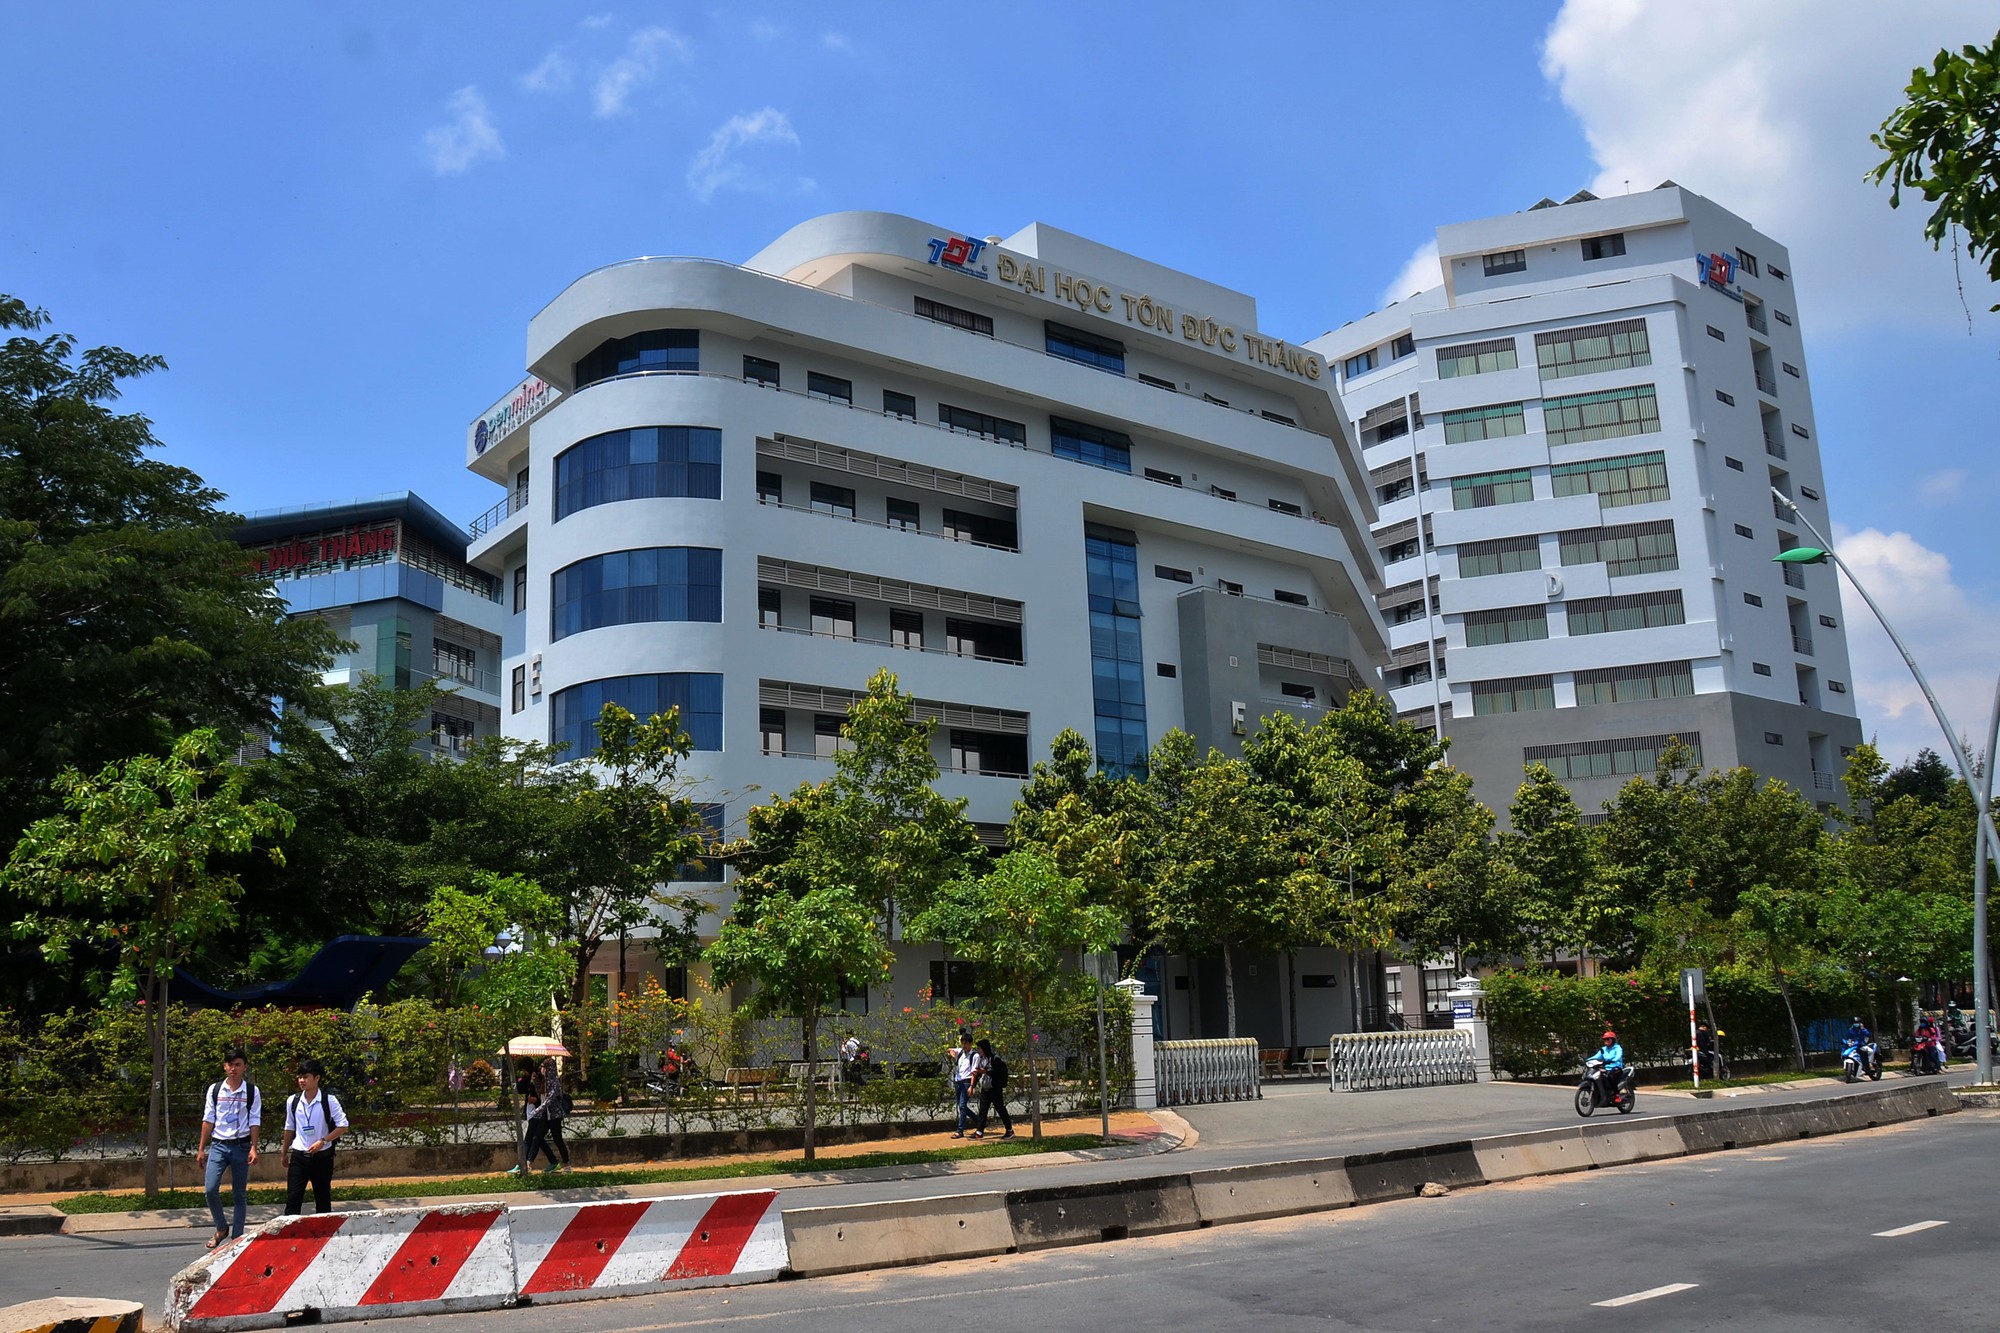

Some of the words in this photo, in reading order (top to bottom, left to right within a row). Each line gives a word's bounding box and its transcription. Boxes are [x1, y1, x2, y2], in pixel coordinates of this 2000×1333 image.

[928, 236, 988, 265] TDT
[1696, 251, 1740, 285] TDT
[997, 253, 1047, 293] ĐẠI
[1054, 272, 1113, 312] HỌC
[1120, 293, 1175, 334] TÔN
[1181, 313, 1238, 353] ĐỨC
[1243, 338, 1321, 380] THẮNG
[268, 540, 312, 572] ĐỨC
[1545, 573, 1563, 597] D
